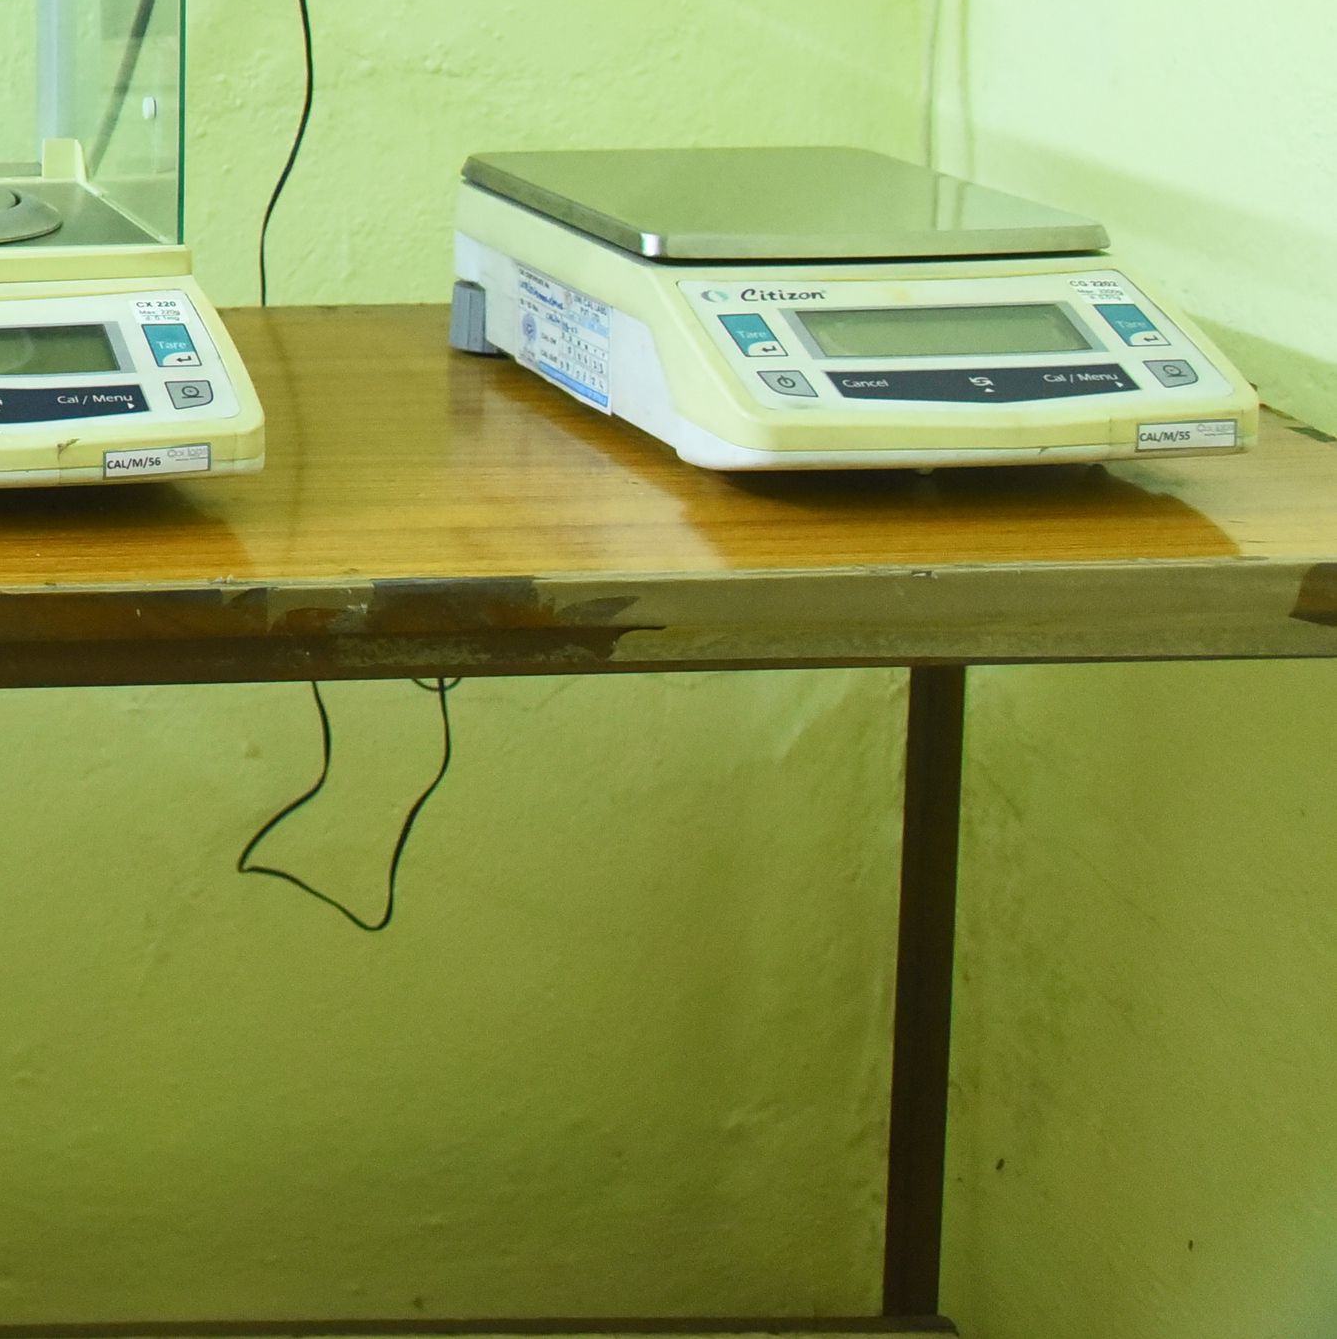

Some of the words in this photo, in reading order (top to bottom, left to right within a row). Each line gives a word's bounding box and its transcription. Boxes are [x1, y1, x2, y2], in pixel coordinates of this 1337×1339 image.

[740, 288, 825, 302] Citizon
[1115, 320, 1146, 329] Tare
[736, 330, 767, 339] Tare
[156, 341, 187, 349] Tare
[842, 378, 889, 388] Cancel
[1043, 373, 1066, 383] Cal
[1069, 373, 1075, 383] /
[1077, 372, 1119, 381] Menu
[57, 395, 79, 405] Cal
[82, 395, 88, 405] /
[92, 394, 133, 403] Menu
[1139, 431, 1191, 442] CAL/M/55
[107, 457, 162, 470] CAL/M/56
